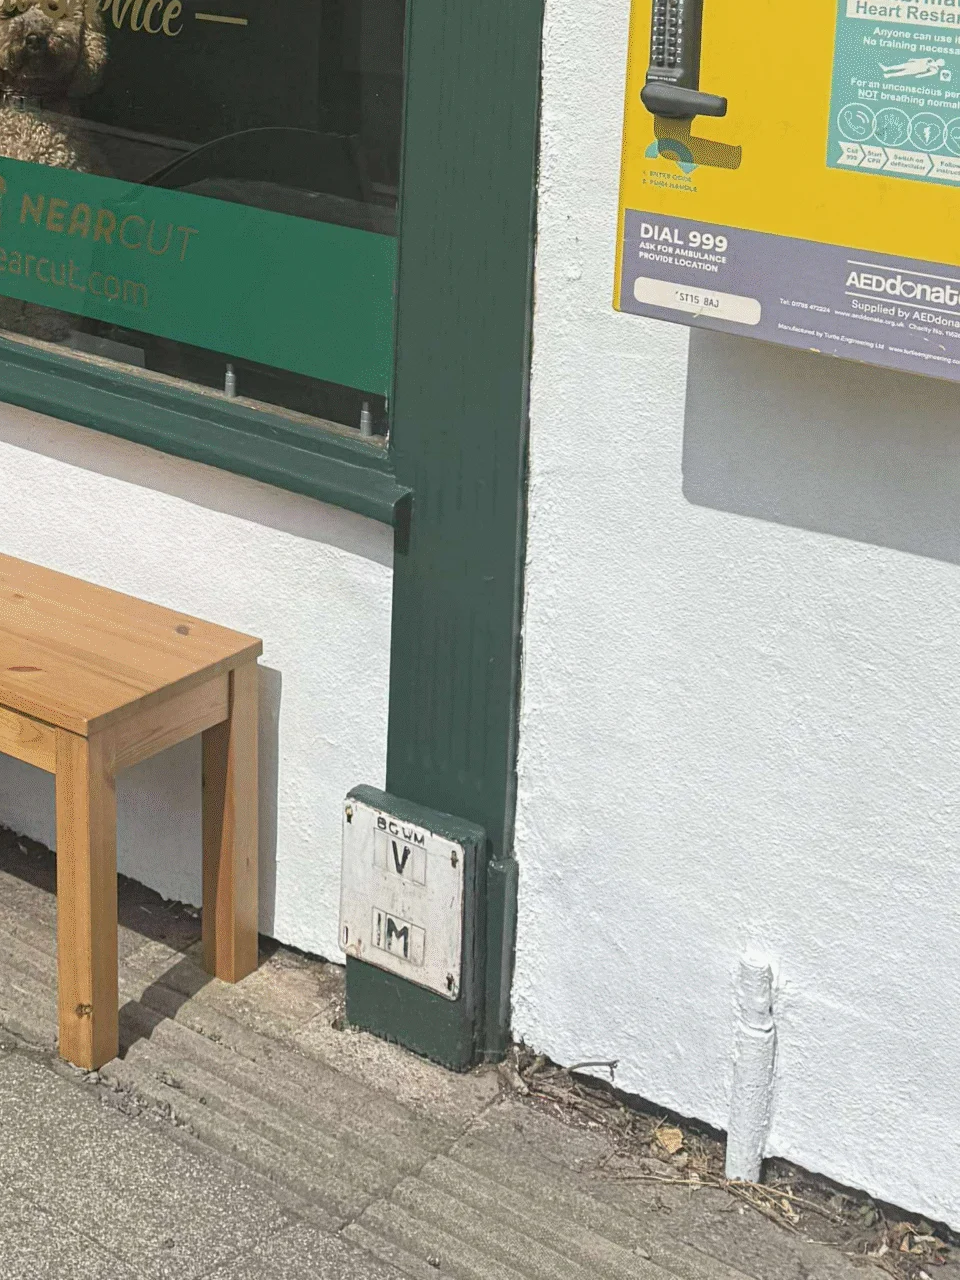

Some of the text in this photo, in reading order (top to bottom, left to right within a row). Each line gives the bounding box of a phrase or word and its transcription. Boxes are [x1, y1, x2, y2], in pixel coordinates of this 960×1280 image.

[855, 0, 901, 18] Heart
[863, 35, 877, 46] No
[879, 37, 917, 52] training
[872, 26, 911, 40] Anyone
[913, 31, 931, 41] can
[934, 35, 952, 44] use
[850, 76, 868, 87] For
[868, 80, 880, 89] an
[882, 82, 942, 97] unconscious
[858, 88, 878, 100] NOT
[880, 90, 925, 106] breathing
[19, 192, 199, 262] NEARCUT
[640, 222, 728, 253] DIAL 999
[638, 250, 719, 273] PROVIDE LOCATION
[639, 241, 727, 264] ASK FOR AMBULANCE
[845, 271, 960, 307] AEDdonat
[679, 292, 720, 308] ST15 8AJ
[851, 299, 895, 317] Supplied
[897, 307, 910, 320] by
[908, 323, 932, 334] Charity
[391, 840, 411, 875] V
